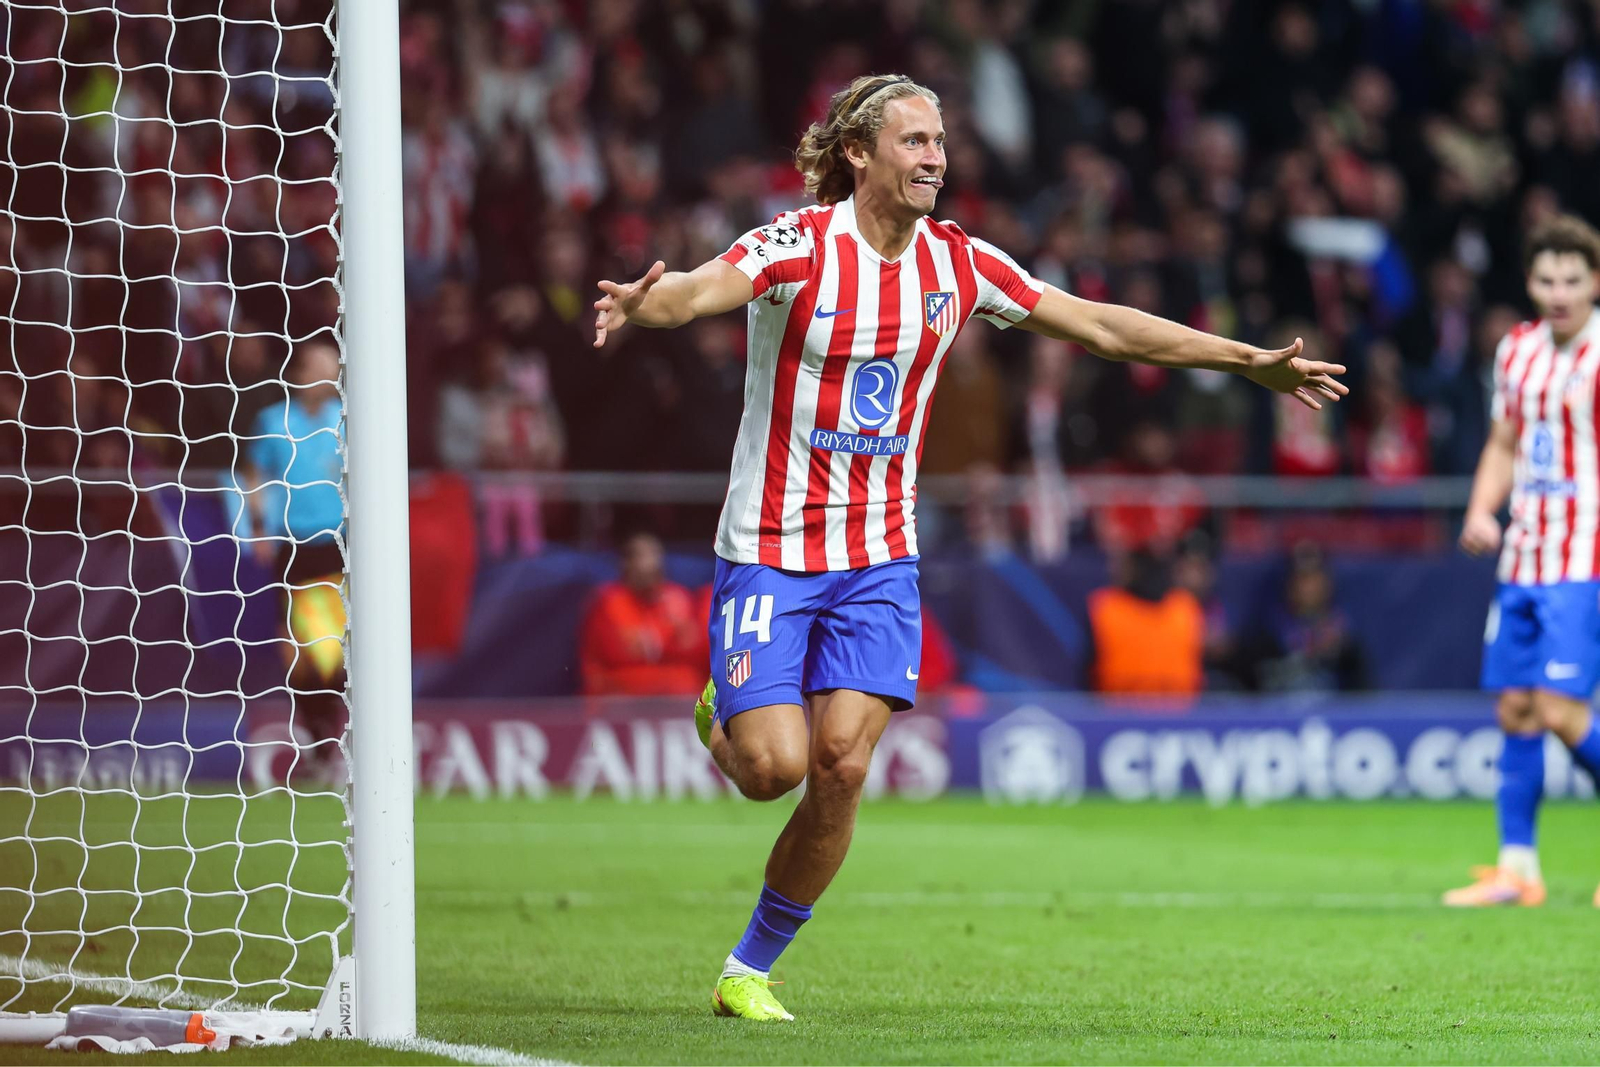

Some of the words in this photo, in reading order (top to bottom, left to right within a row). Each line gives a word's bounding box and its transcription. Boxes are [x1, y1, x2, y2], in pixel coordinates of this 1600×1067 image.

[815, 431, 881, 453] RIYADH
[883, 437, 906, 453] AIR
[722, 594, 774, 650] 14
[249, 719, 549, 803] QAR
[568, 717, 952, 803] AIRS
[339, 981, 352, 1037] FORZA
